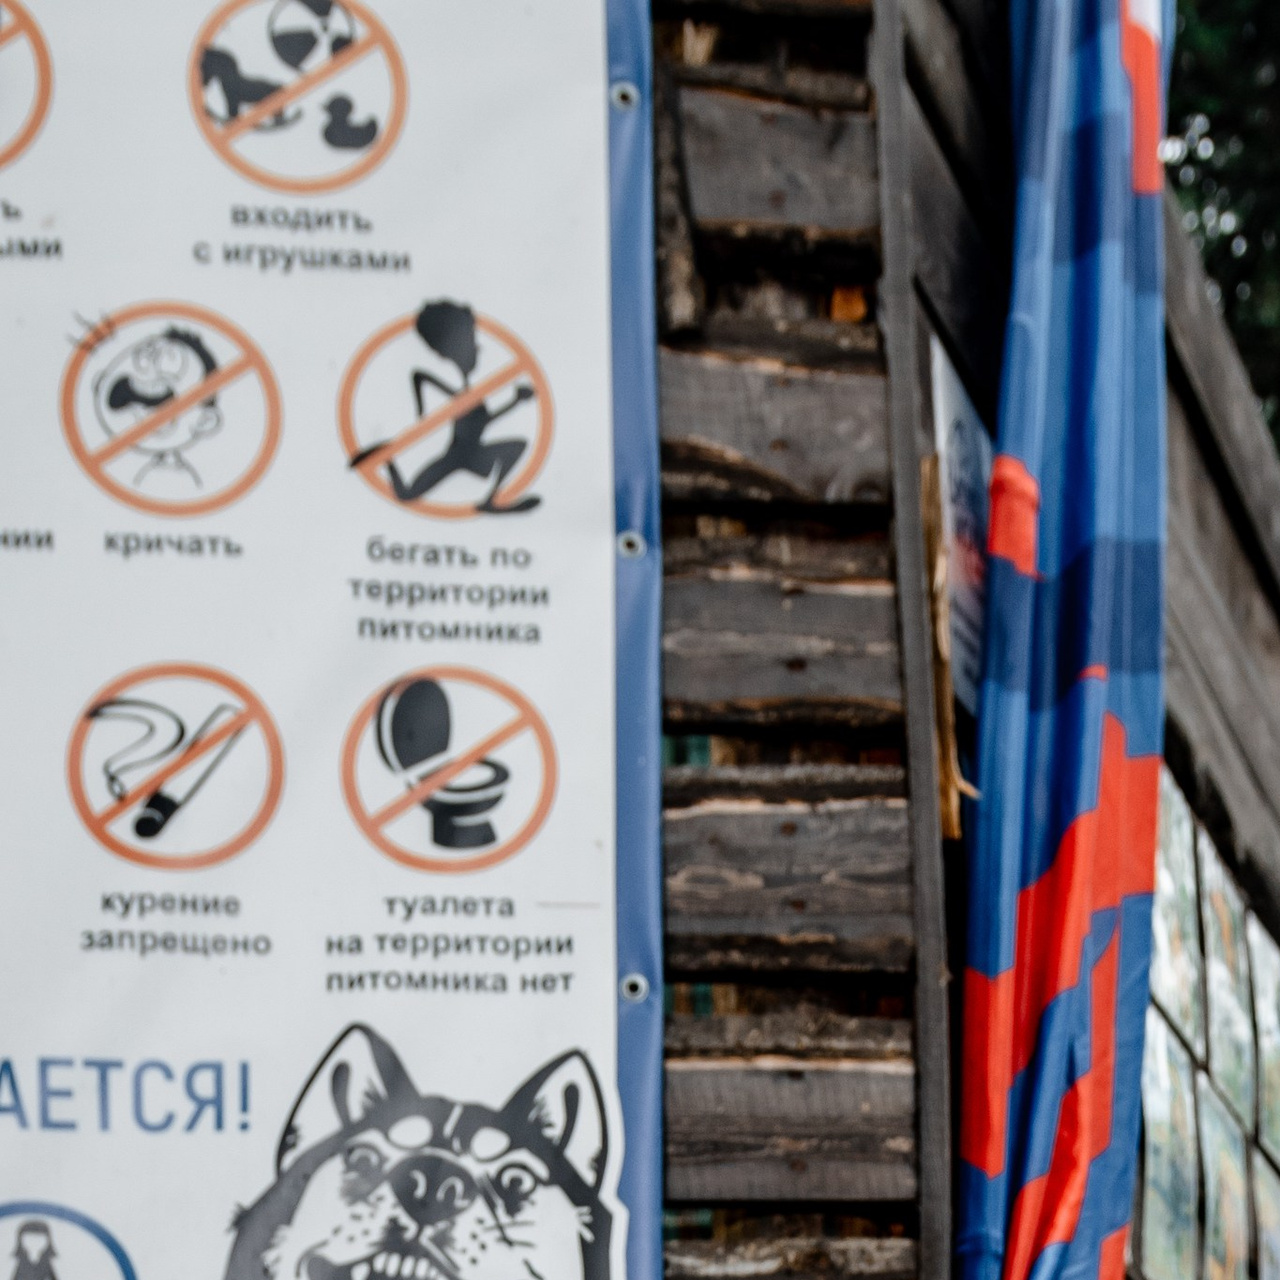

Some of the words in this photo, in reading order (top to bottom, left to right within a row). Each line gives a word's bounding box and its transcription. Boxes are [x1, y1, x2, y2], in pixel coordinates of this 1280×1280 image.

[231, 205, 372, 231] входить
[193, 246, 210, 263] с
[223, 246, 411, 273] игрушками
[104, 533, 242, 557] кричать
[367, 537, 478, 567] бегать
[490, 547, 531, 567] по
[350, 579, 549, 608] территории
[357, 618, 540, 643] питомника
[101, 893, 240, 918] курение
[385, 895, 515, 921] туалета
[81, 929, 271, 956] запрещено
[326, 935, 362, 954] на
[375, 934, 574, 959] территории
[326, 970, 507, 992] питомника
[520, 973, 573, 993] нет
